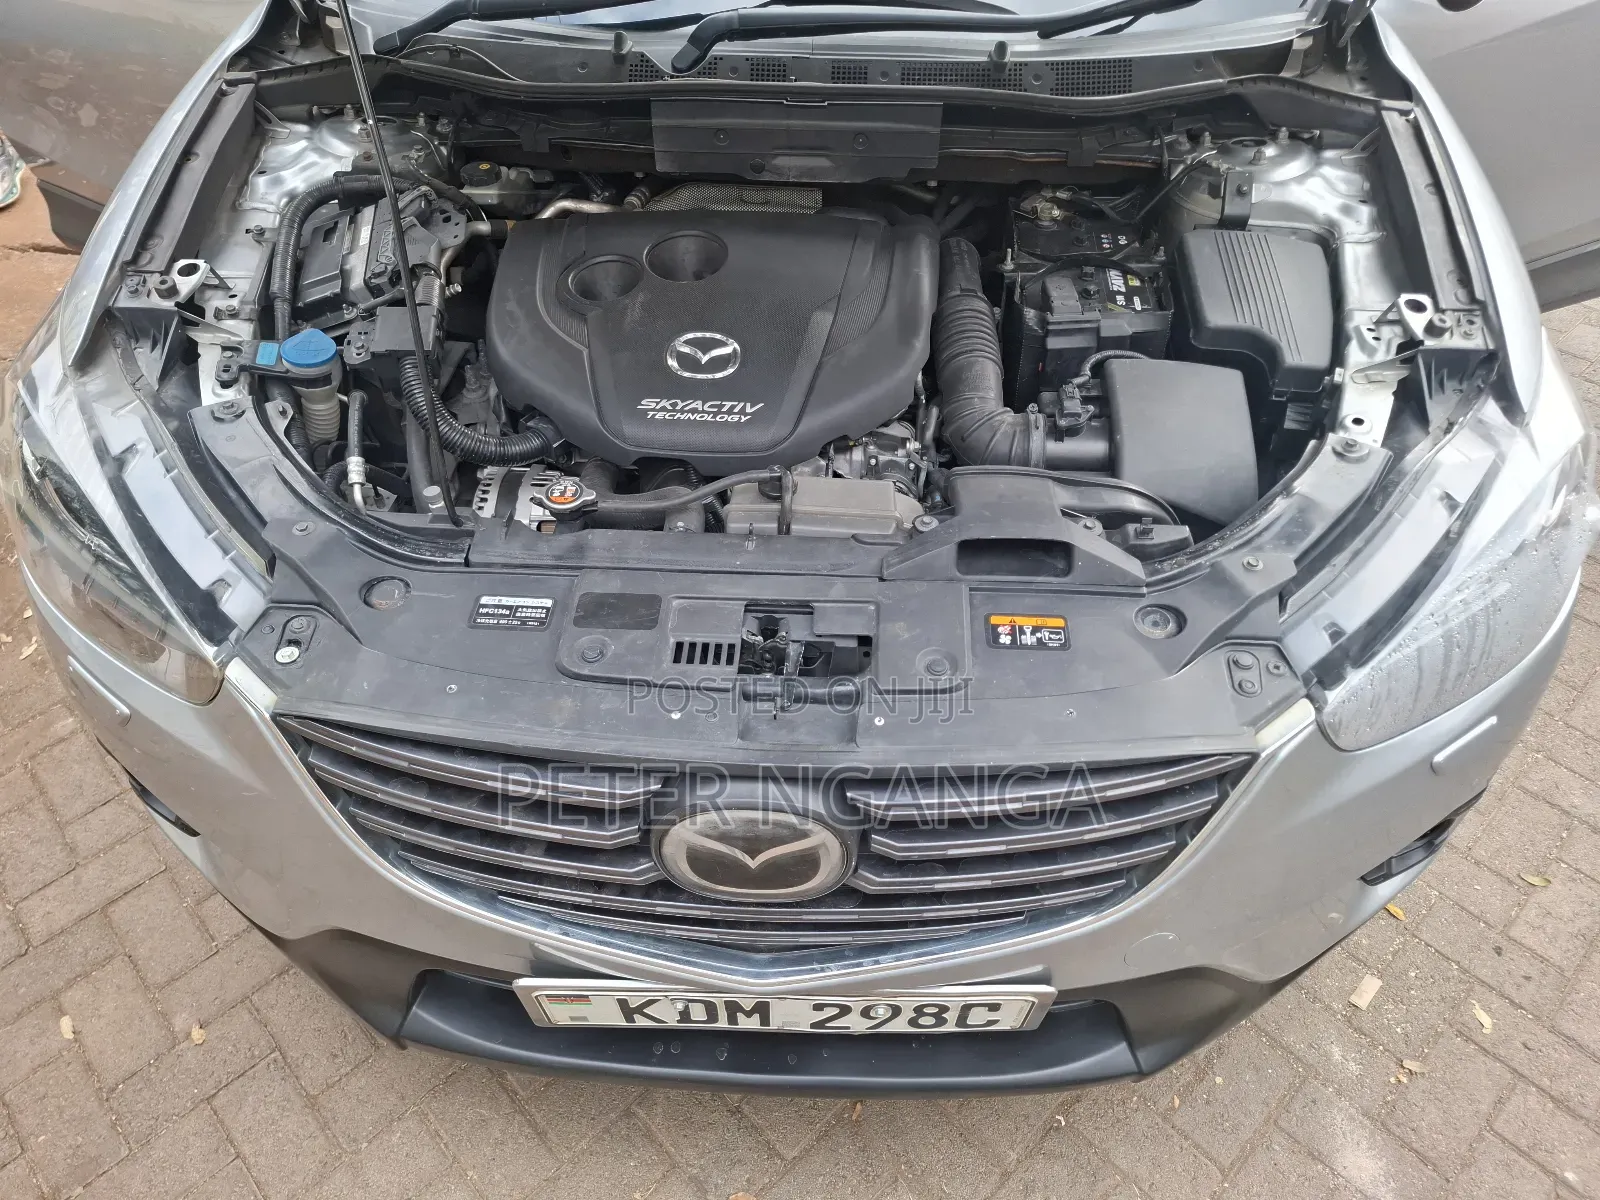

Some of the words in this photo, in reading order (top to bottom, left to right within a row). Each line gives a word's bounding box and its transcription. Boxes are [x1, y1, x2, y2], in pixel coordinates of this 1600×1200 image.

[637, 399, 764, 413] SKYACTIV
[647, 412, 752, 422] TECHNOLOGY
[615, 997, 772, 1028] KDM
[809, 1001, 1002, 1031] 298C
